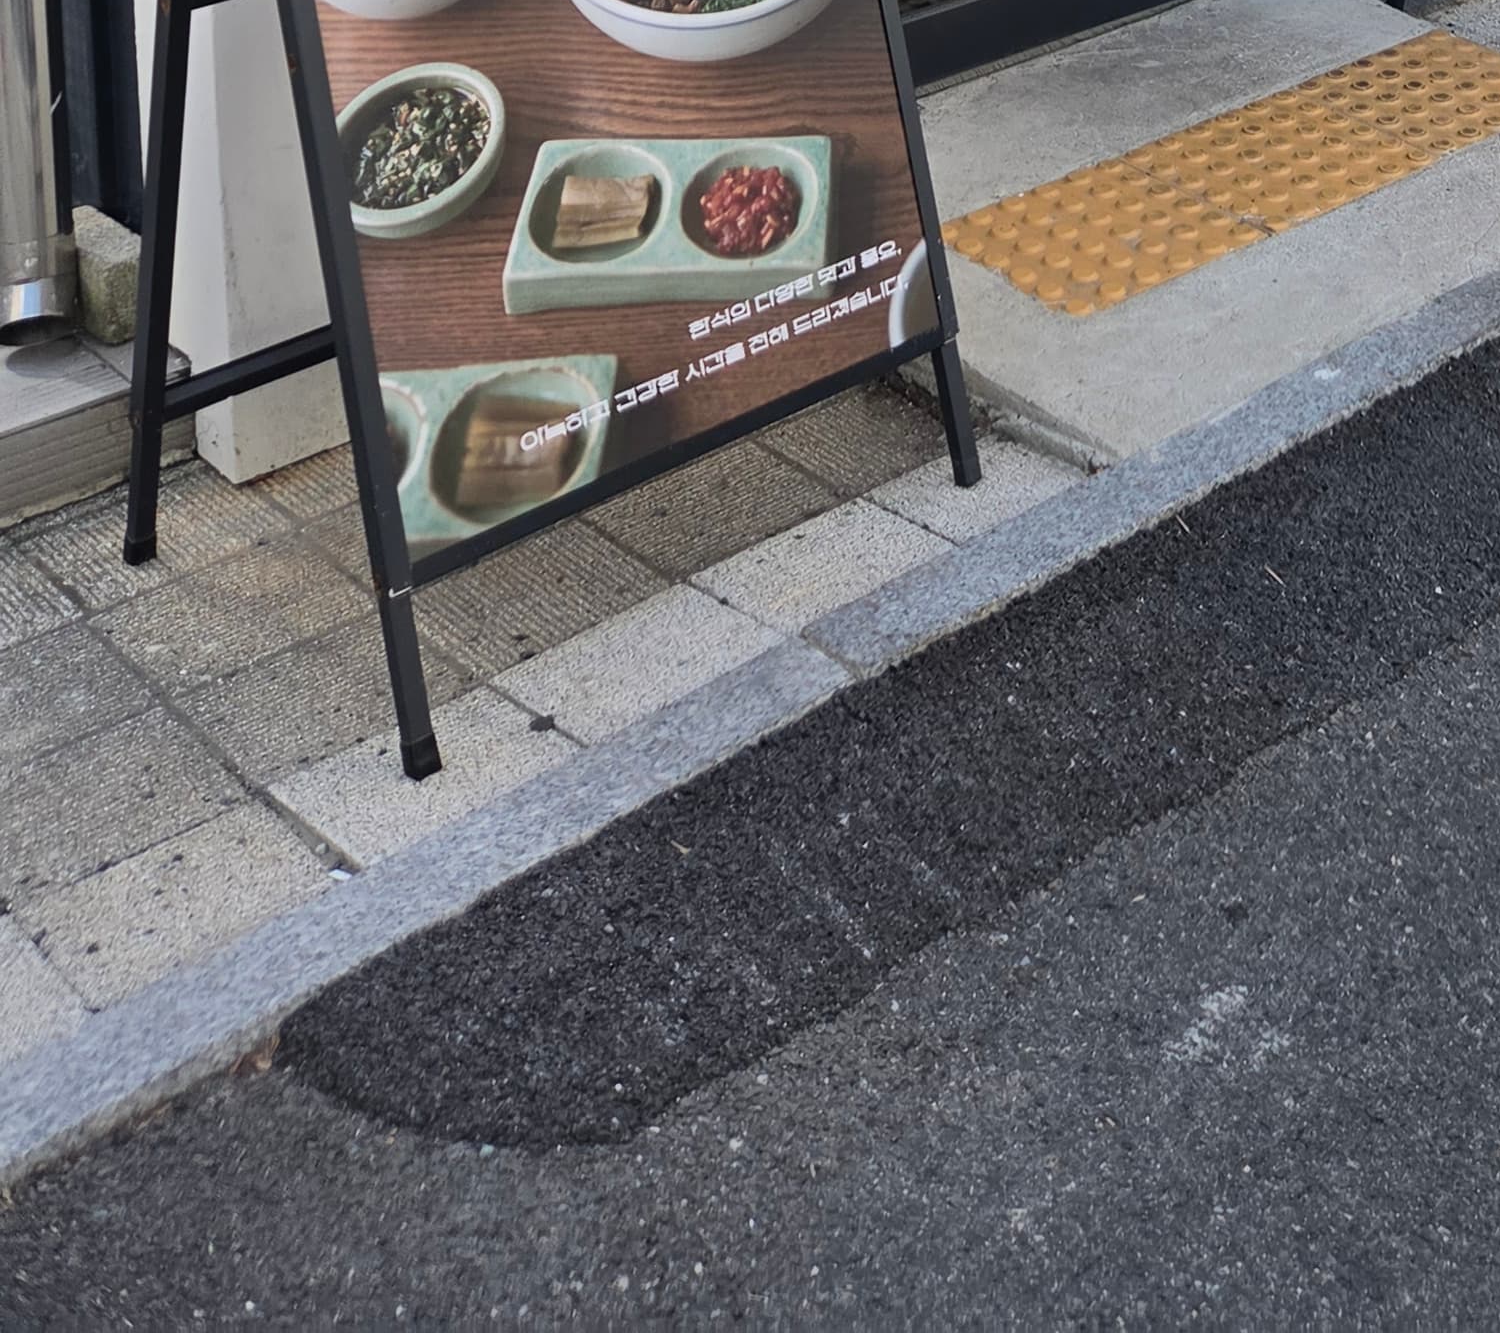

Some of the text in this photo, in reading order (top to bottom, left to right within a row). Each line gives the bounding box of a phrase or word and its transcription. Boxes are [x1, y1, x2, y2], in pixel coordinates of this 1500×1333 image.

[687, 301, 750, 341] 한식의
[754, 272, 814, 314] 다양한
[615, 368, 680, 414] 건강한
[684, 341, 746, 383] 시간을
[748, 323, 790, 355] 전해
